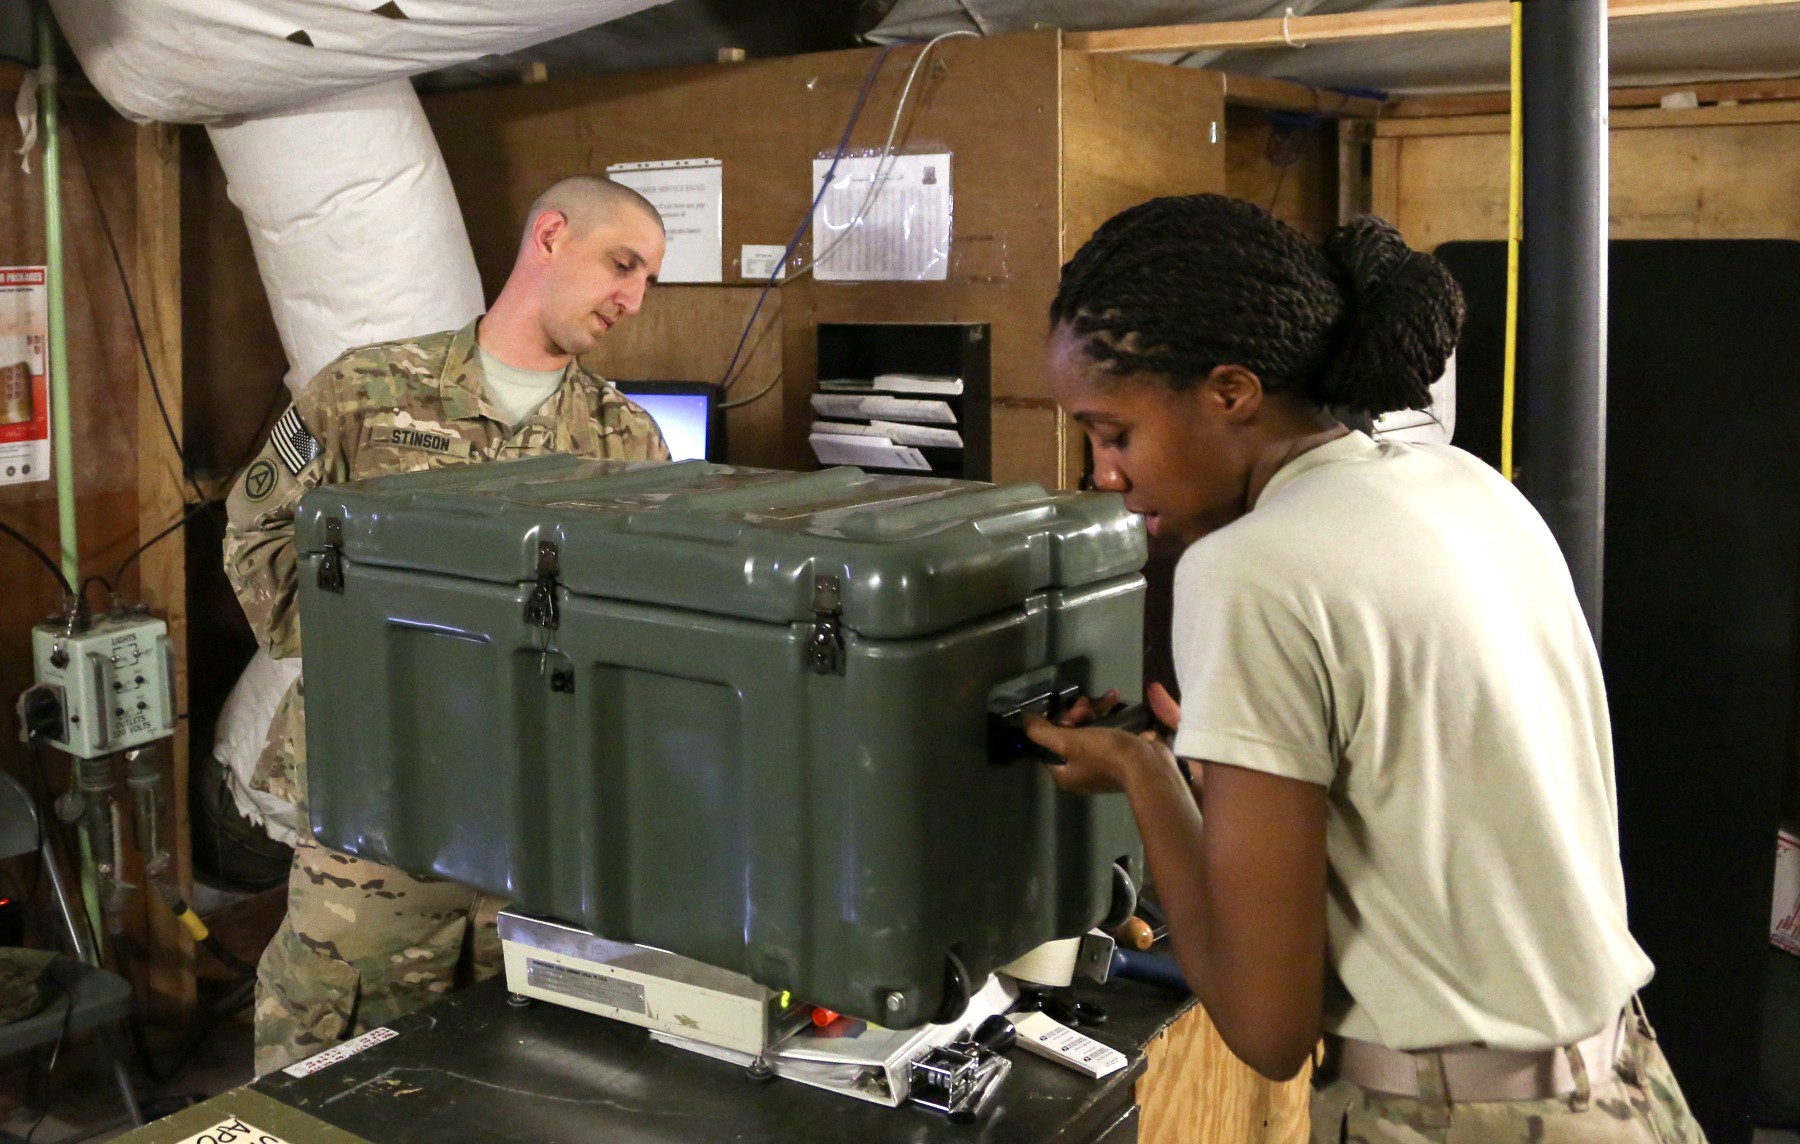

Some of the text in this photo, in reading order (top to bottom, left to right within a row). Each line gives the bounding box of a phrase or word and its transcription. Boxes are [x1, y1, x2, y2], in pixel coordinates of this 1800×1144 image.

[391, 429, 450, 451] STINSON
[111, 634, 137, 645] LIGHTS
[115, 715, 146, 729] OUTLETS
[129, 721, 151, 734] VOLTS
